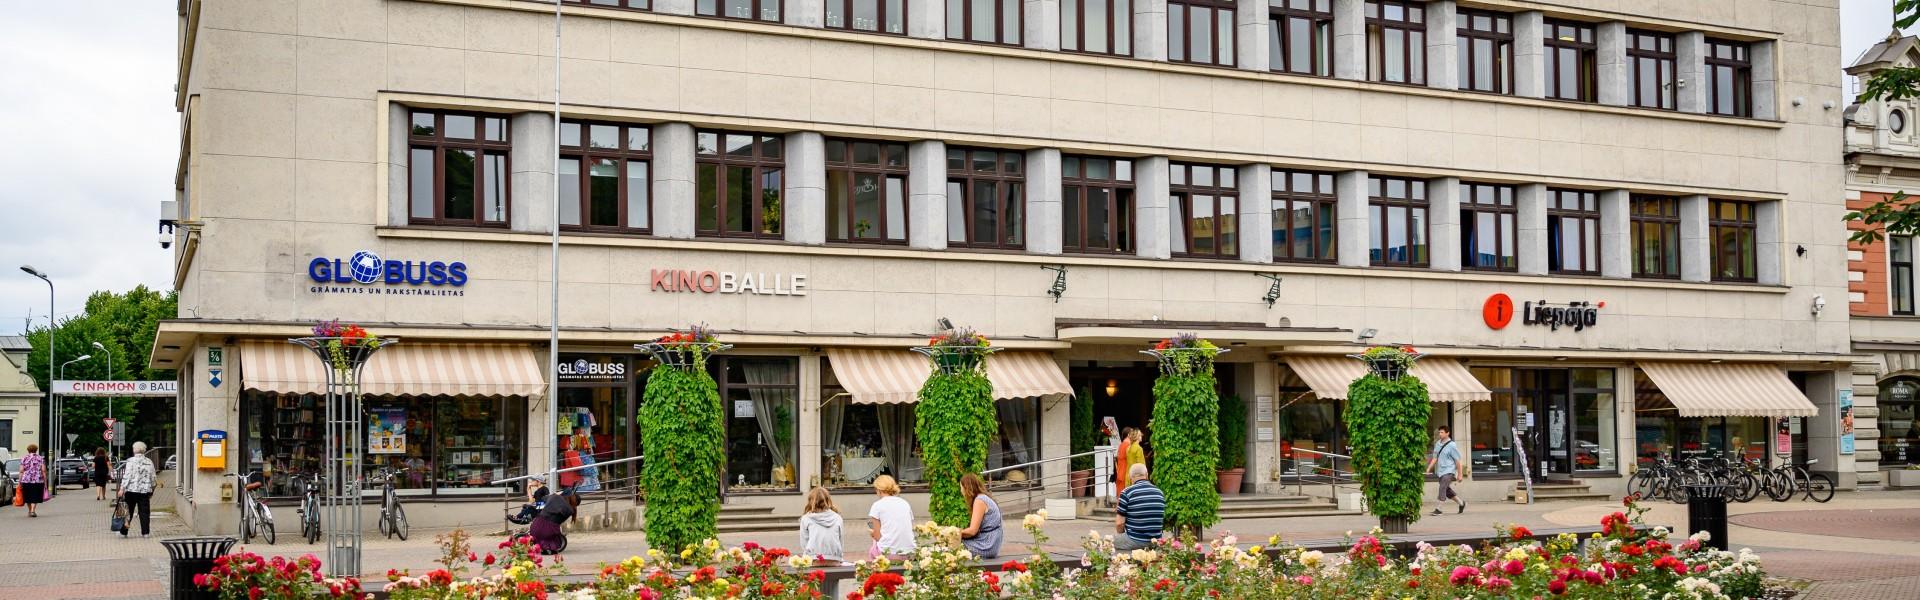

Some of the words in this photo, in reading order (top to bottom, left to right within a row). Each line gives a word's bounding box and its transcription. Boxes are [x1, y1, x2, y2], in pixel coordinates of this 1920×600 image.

[309, 250, 468, 287] GLOBUSS
[311, 285, 364, 294] GRĀMATAS
[386, 288, 465, 297] RAKSTĀMLIETAS
[650, 269, 808, 297] KINOBALLE
[558, 359, 625, 375] GLOBUSS
[73, 382, 136, 391] CINAMON
